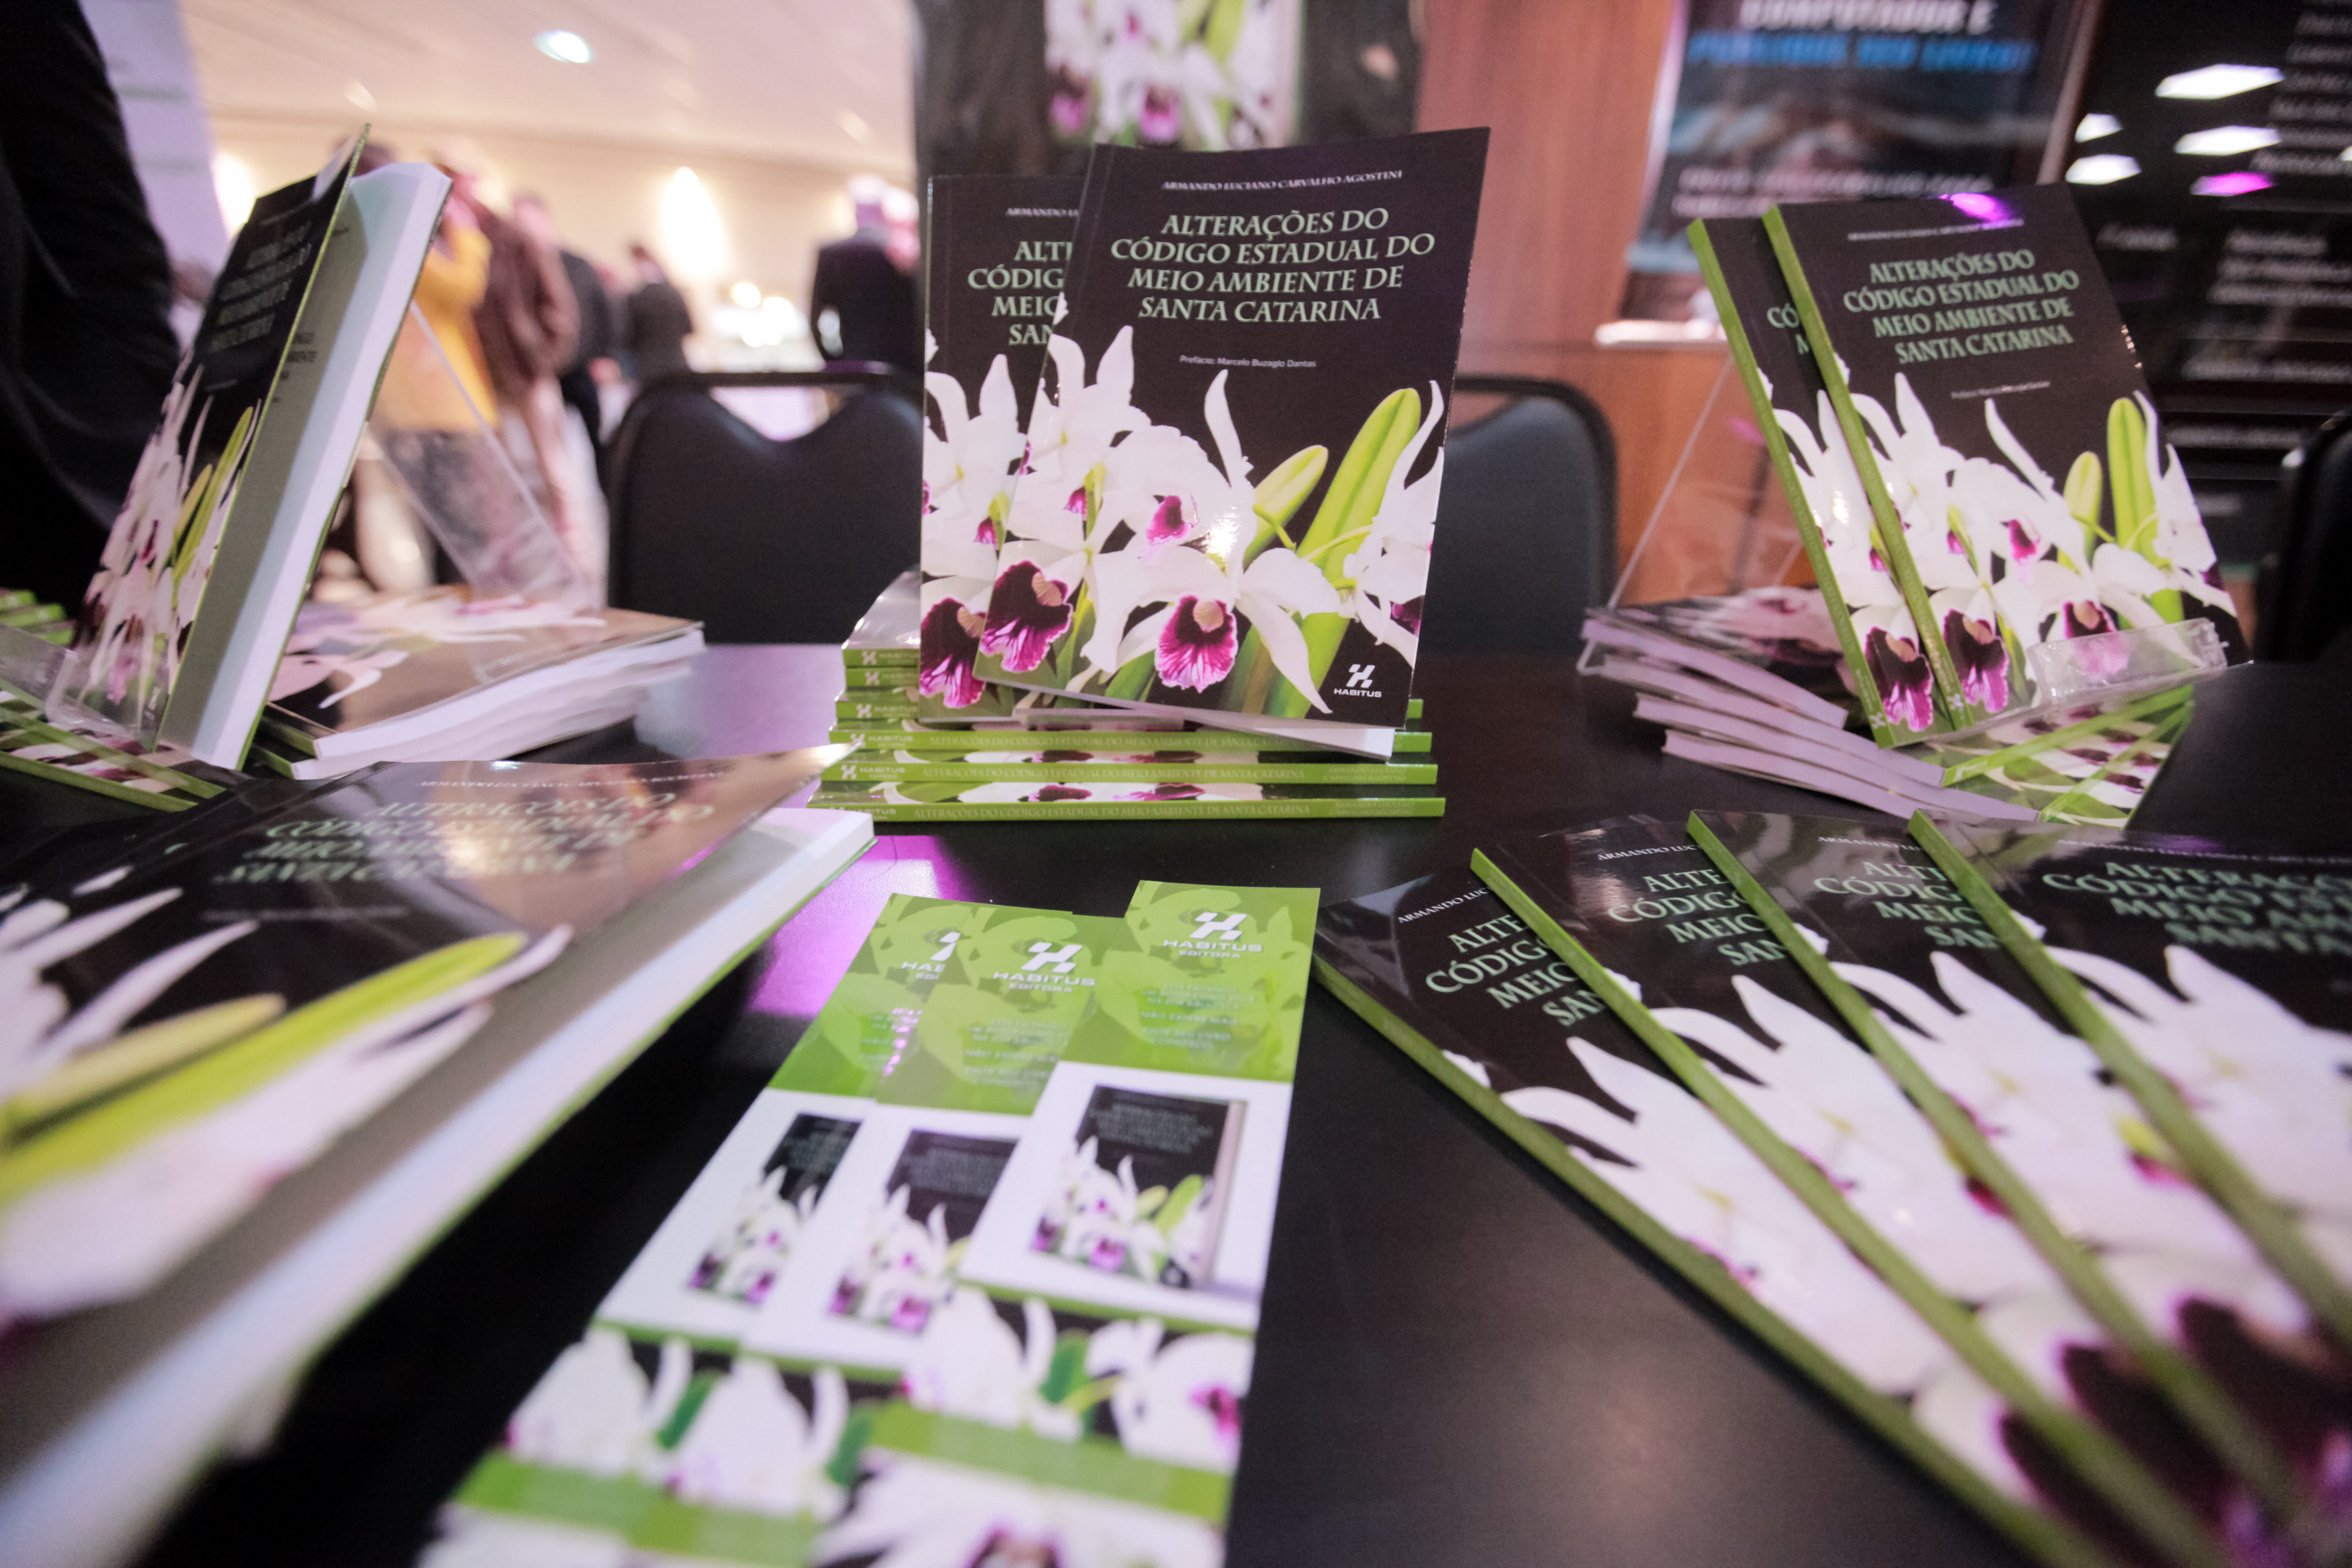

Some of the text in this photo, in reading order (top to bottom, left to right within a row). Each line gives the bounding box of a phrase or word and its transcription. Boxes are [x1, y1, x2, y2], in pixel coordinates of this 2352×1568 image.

[1161, 170, 1403, 191] ARMANDO LUCIANO CARVALHO AGOSTINI
[1160, 207, 1390, 242] ALTERAÇÕES DO
[1110, 233, 1436, 265] CÓDIGO ESTADUAL DO
[1870, 249, 2035, 284] ALTERAÇÕES DO
[1128, 265, 1405, 293] MEIO AMBIENTE DE
[1843, 268, 2080, 312] CÓDIGO ESTADUAL DO
[1138, 296, 1382, 322] SANTA CATARINA
[1872, 296, 2075, 338] MEIO AMBIENTE DE
[1894, 323, 2075, 364] SANTA CATARINA
[1217, 358, 1250, 366] Marcelo
[1286, 359, 1317, 368] Dantas
[1333, 688, 1383, 698] HABITUS
[985, 769, 1003, 777] DO
[1004, 766, 1050, 778] CÓDIGO
[1102, 769, 1120, 778] DO
[1121, 769, 1149, 778] MEIO
[1149, 769, 1202, 778] AMBIENTE
[1252, 769, 1305, 779] CATARINA
[913, 805, 1310, 819] ALTERAÇÕES DO CÓDIGO ESTADUAL DO MEIO AMBIENTE DE SANTA CATARINA
[1598, 846, 1670, 861] ARMANDO
[1396, 897, 1464, 924] ARMANDO
[1162, 939, 1263, 953] HABITUS
[1178, 949, 1242, 959] EDITORA
[992, 971, 1096, 987] HABITUS
[1008, 982, 1073, 994] EDITORA
